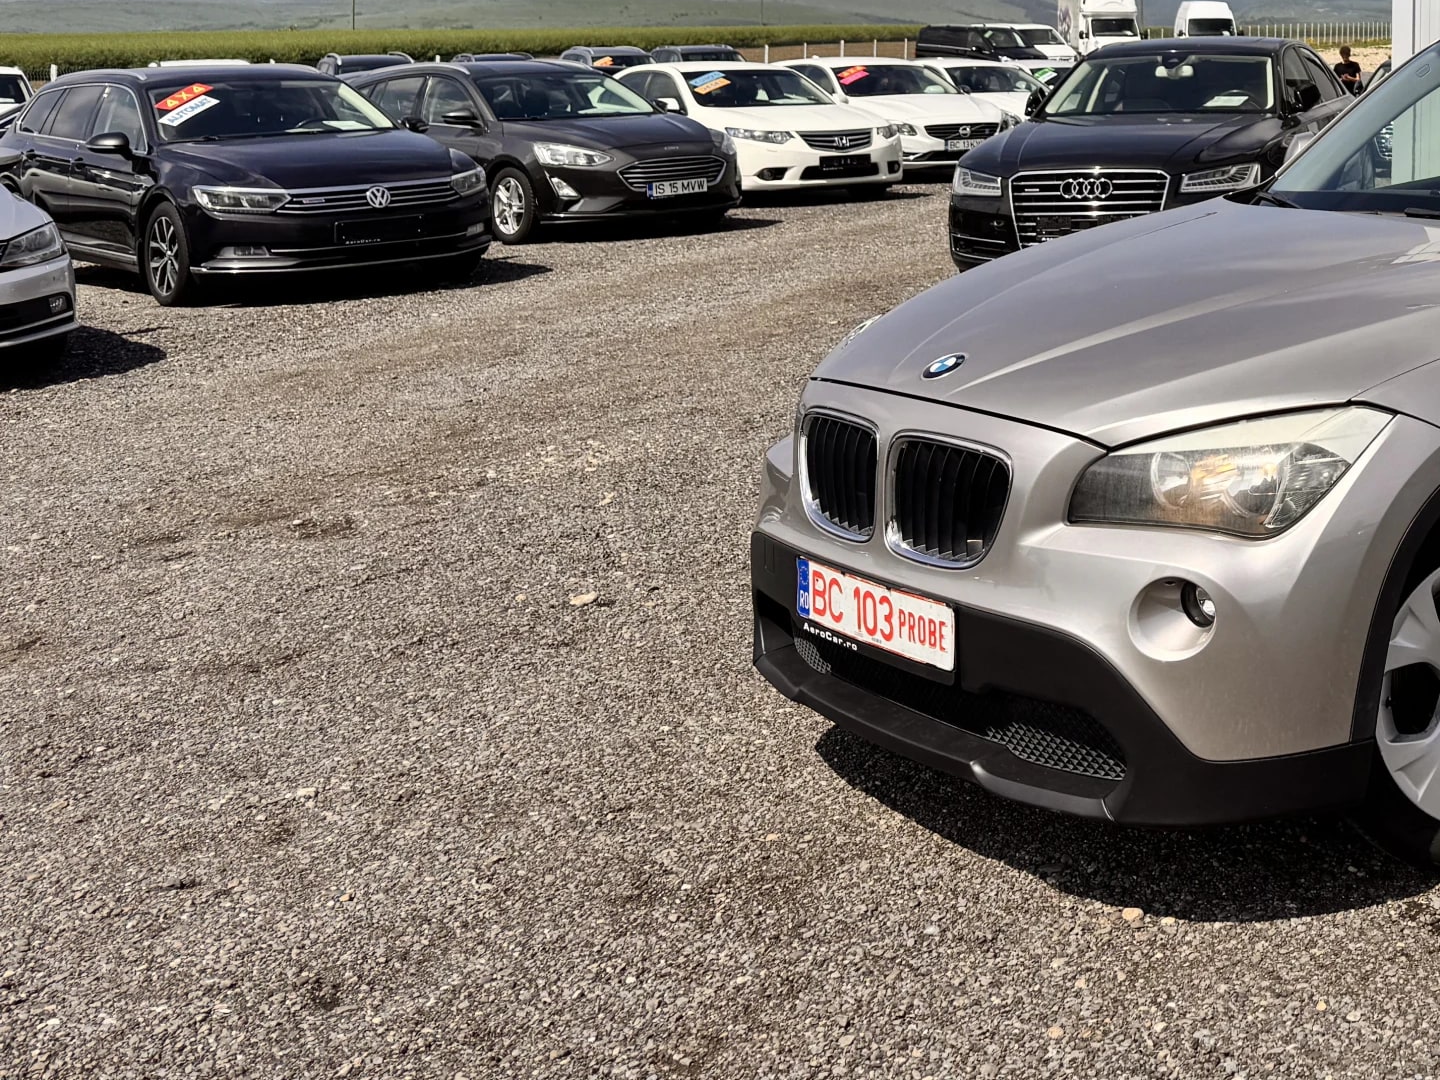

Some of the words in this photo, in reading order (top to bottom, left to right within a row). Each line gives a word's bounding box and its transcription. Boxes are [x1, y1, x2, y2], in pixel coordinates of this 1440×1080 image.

[655, 183, 666, 195] IS
[669, 182, 679, 194] 15
[682, 179, 705, 193] MVW
[799, 589, 810, 610] RO
[812, 570, 844, 624] BC
[853, 586, 894, 642] 103
[898, 608, 949, 653] PROBE
[803, 622, 858, 651] AeroCar.ro
